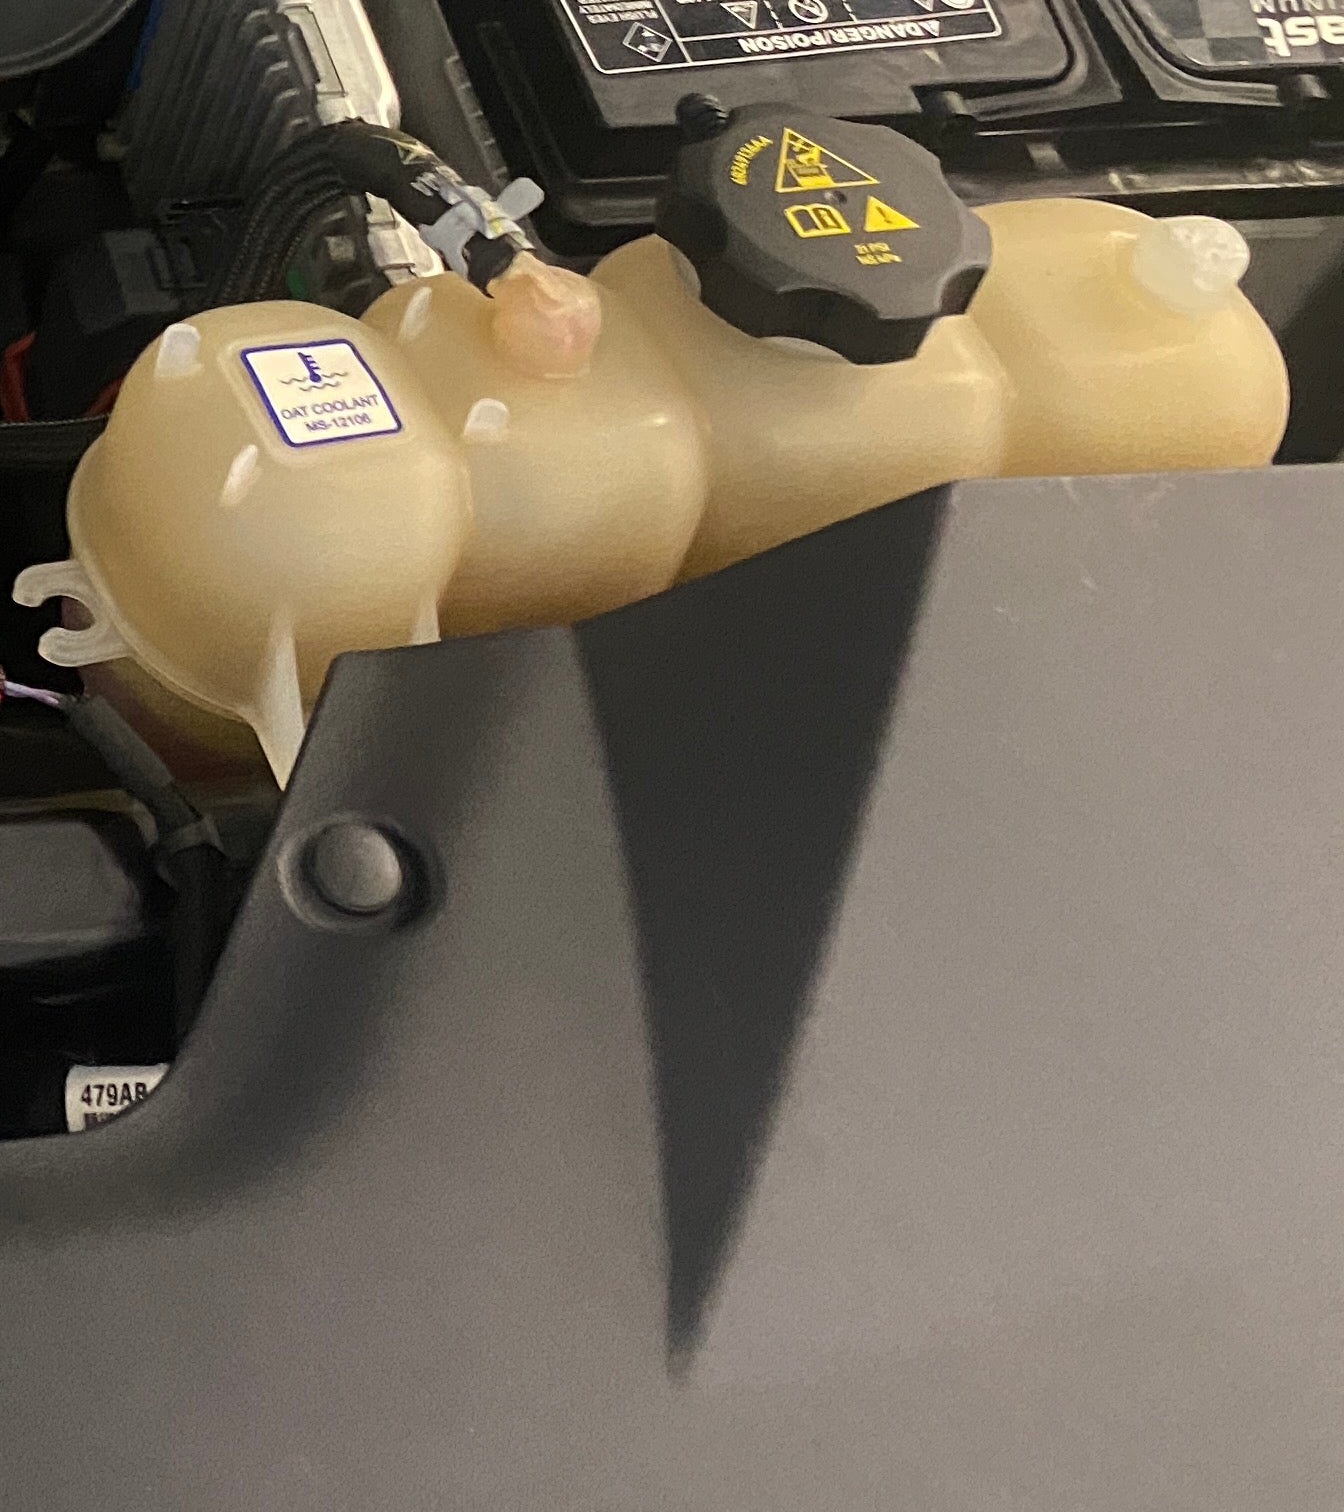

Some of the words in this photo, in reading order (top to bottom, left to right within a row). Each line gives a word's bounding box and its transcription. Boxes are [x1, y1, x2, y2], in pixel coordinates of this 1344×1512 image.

[738, 19, 925, 53] DANGER/POISON
[281, 406, 307, 419] OAT
[312, 394, 377, 414] COOLANT
